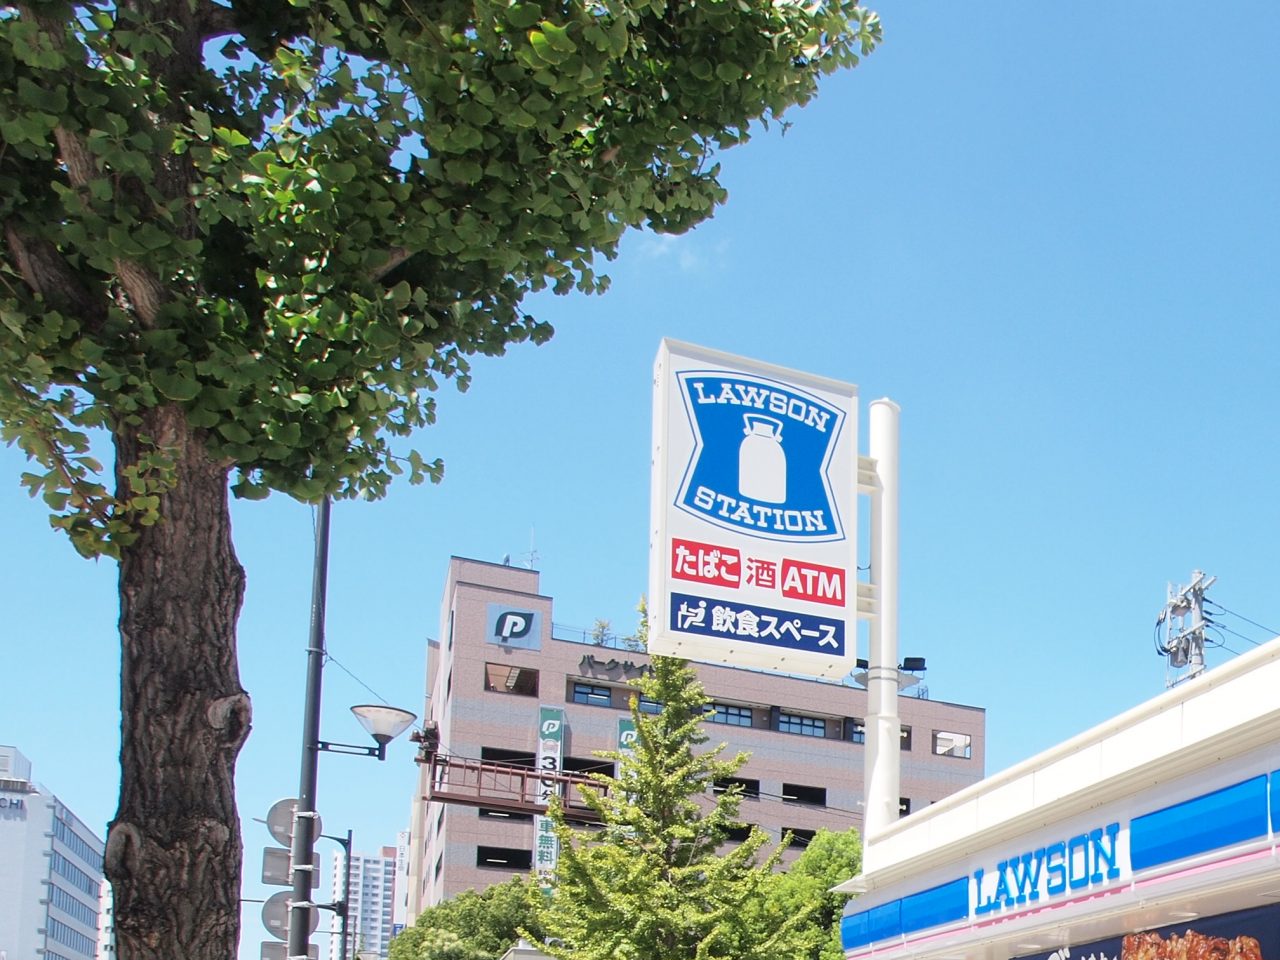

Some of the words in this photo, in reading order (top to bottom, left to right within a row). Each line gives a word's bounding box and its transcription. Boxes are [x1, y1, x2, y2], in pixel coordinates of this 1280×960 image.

[694, 382, 830, 433] LAWSON
[695, 485, 827, 533] STATION
[675, 545, 740, 584] たばこ
[746, 557, 777, 589] 酒
[783, 568, 843, 601] ATM
[711, 606, 840, 649] 飲食スペース
[973, 822, 1120, 915] LAWSON
